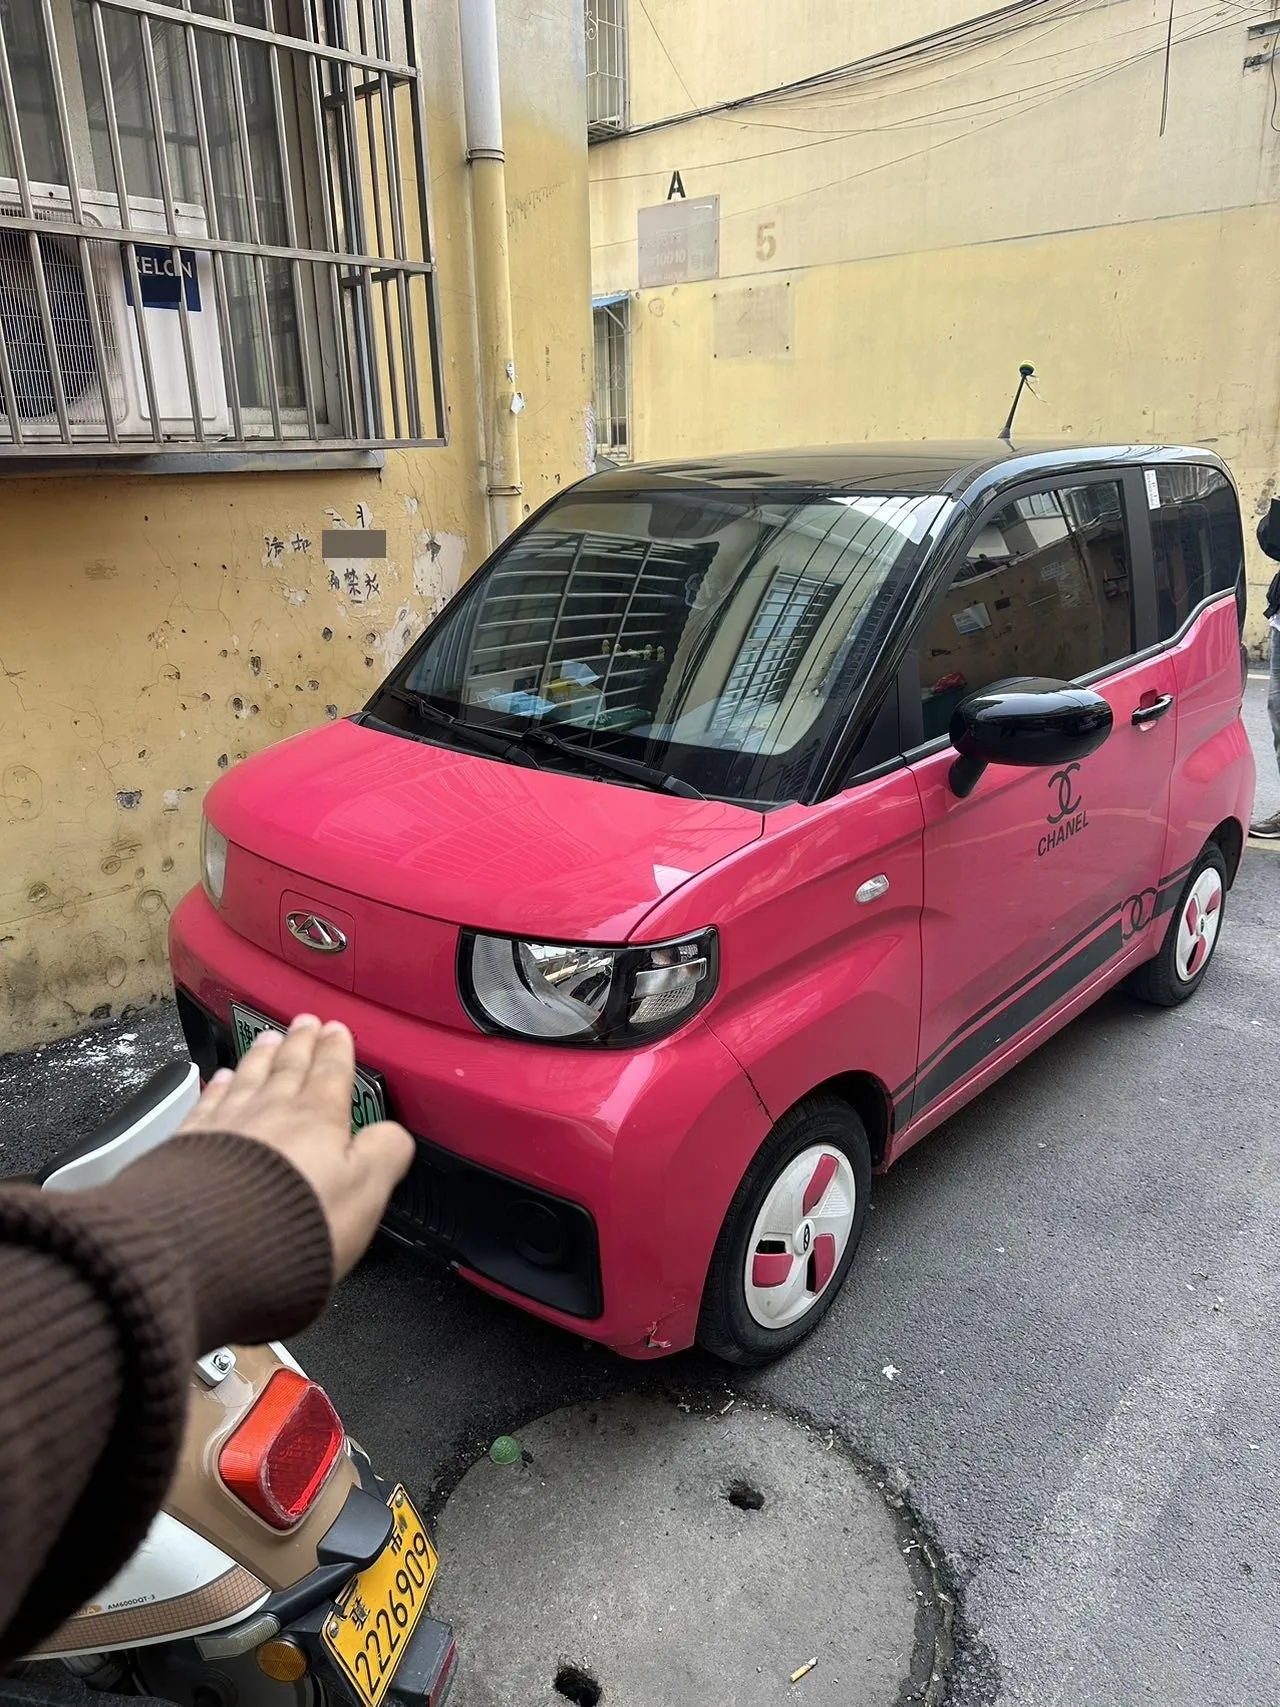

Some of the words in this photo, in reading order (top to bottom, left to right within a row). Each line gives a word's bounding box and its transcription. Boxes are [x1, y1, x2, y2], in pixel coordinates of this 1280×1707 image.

[755, 221, 777, 261] 5
[1038, 810, 1089, 857] CHANEL
[354, 1532, 431, 1697] 2226909
